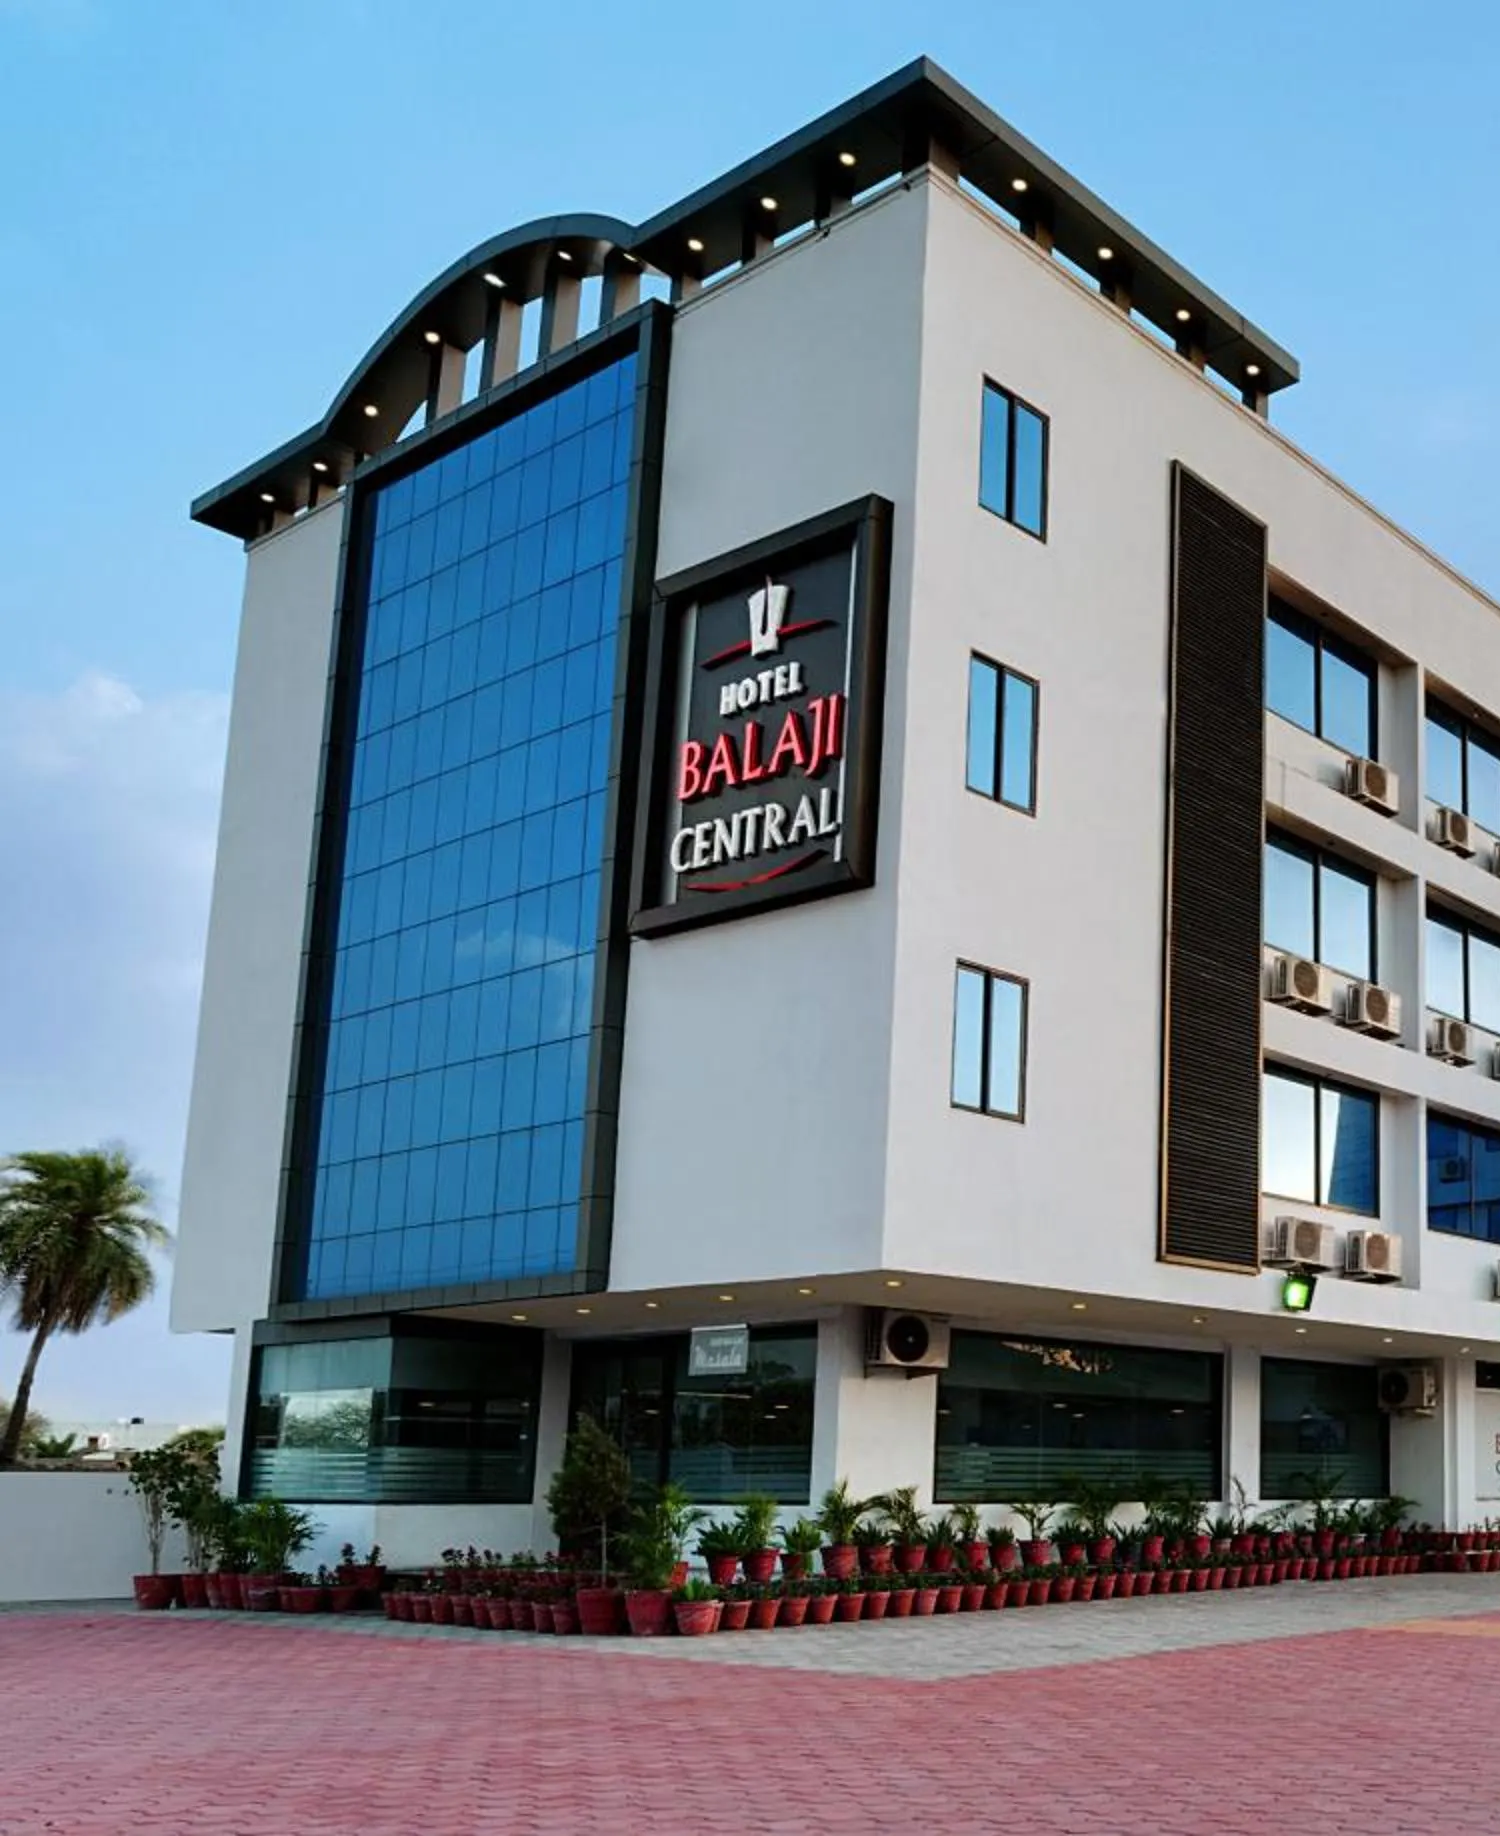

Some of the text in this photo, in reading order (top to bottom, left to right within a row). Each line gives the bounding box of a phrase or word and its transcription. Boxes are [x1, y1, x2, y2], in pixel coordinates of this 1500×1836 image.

[720, 661, 804, 716] HOTEL
[677, 693, 846, 804] BALAJI
[670, 788, 839, 873] CENTRAL
